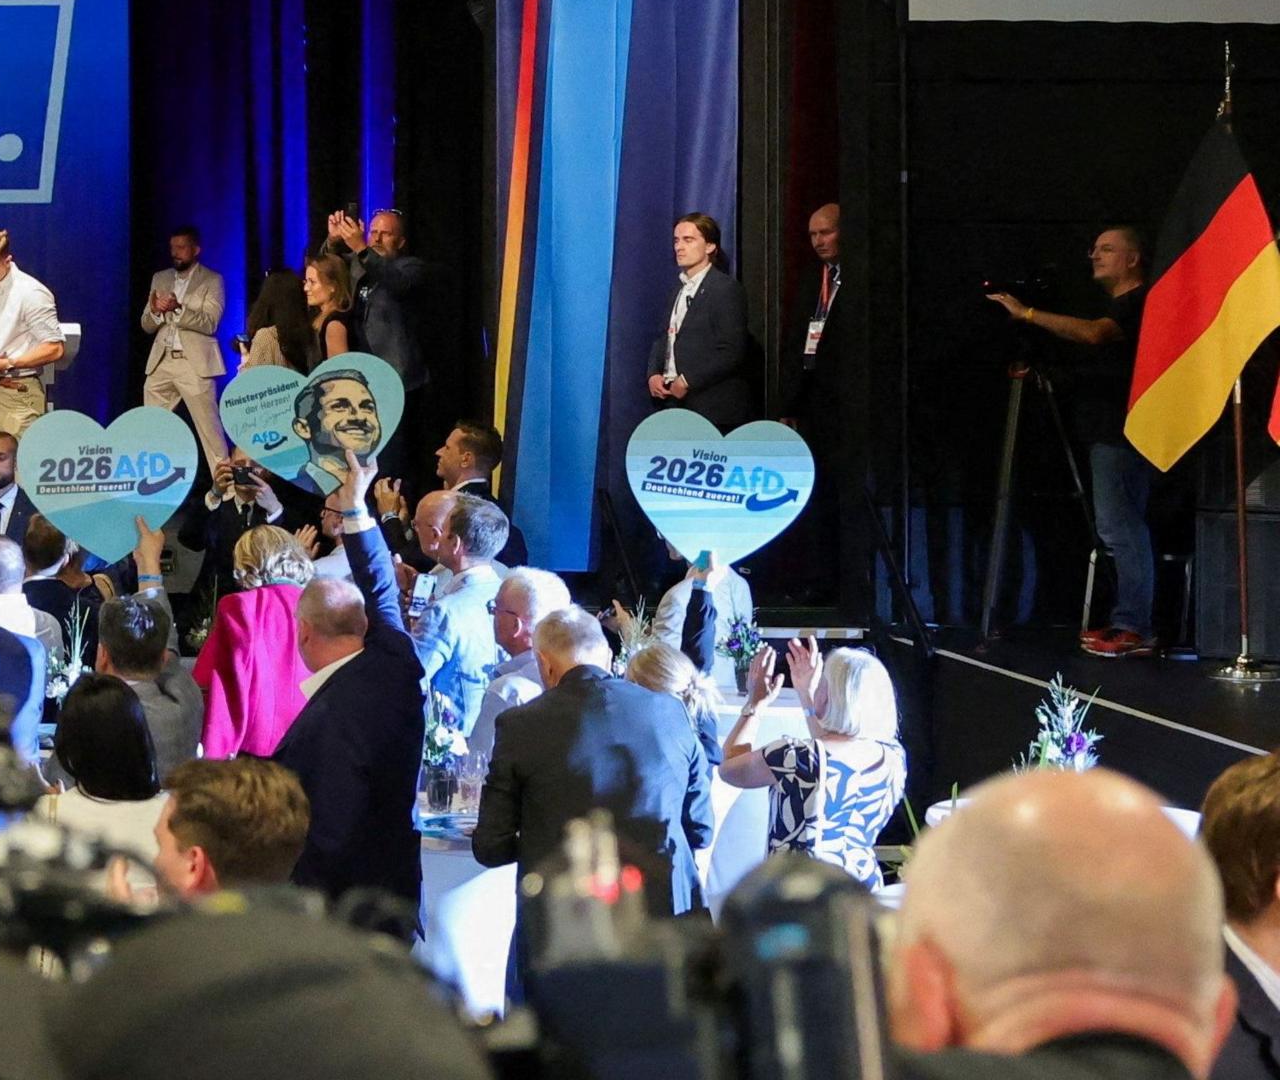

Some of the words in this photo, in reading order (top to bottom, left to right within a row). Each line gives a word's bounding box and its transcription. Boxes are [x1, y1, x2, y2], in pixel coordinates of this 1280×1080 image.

[224, 380, 299, 408] Ministerpräsident
[252, 431, 280, 444] AfD
[78, 445, 113, 456] Vision
[692, 448, 728, 463] Vision
[39, 456, 113, 482] 2026
[113, 451, 171, 479] AfD
[647, 455, 725, 487] 2026
[724, 466, 785, 495] AfD
[40, 483, 96, 494] Deutschland
[98, 482, 131, 492] zuerst!
[645, 482, 704, 498] Deutschland
[705, 491, 740, 503] zuerst!
